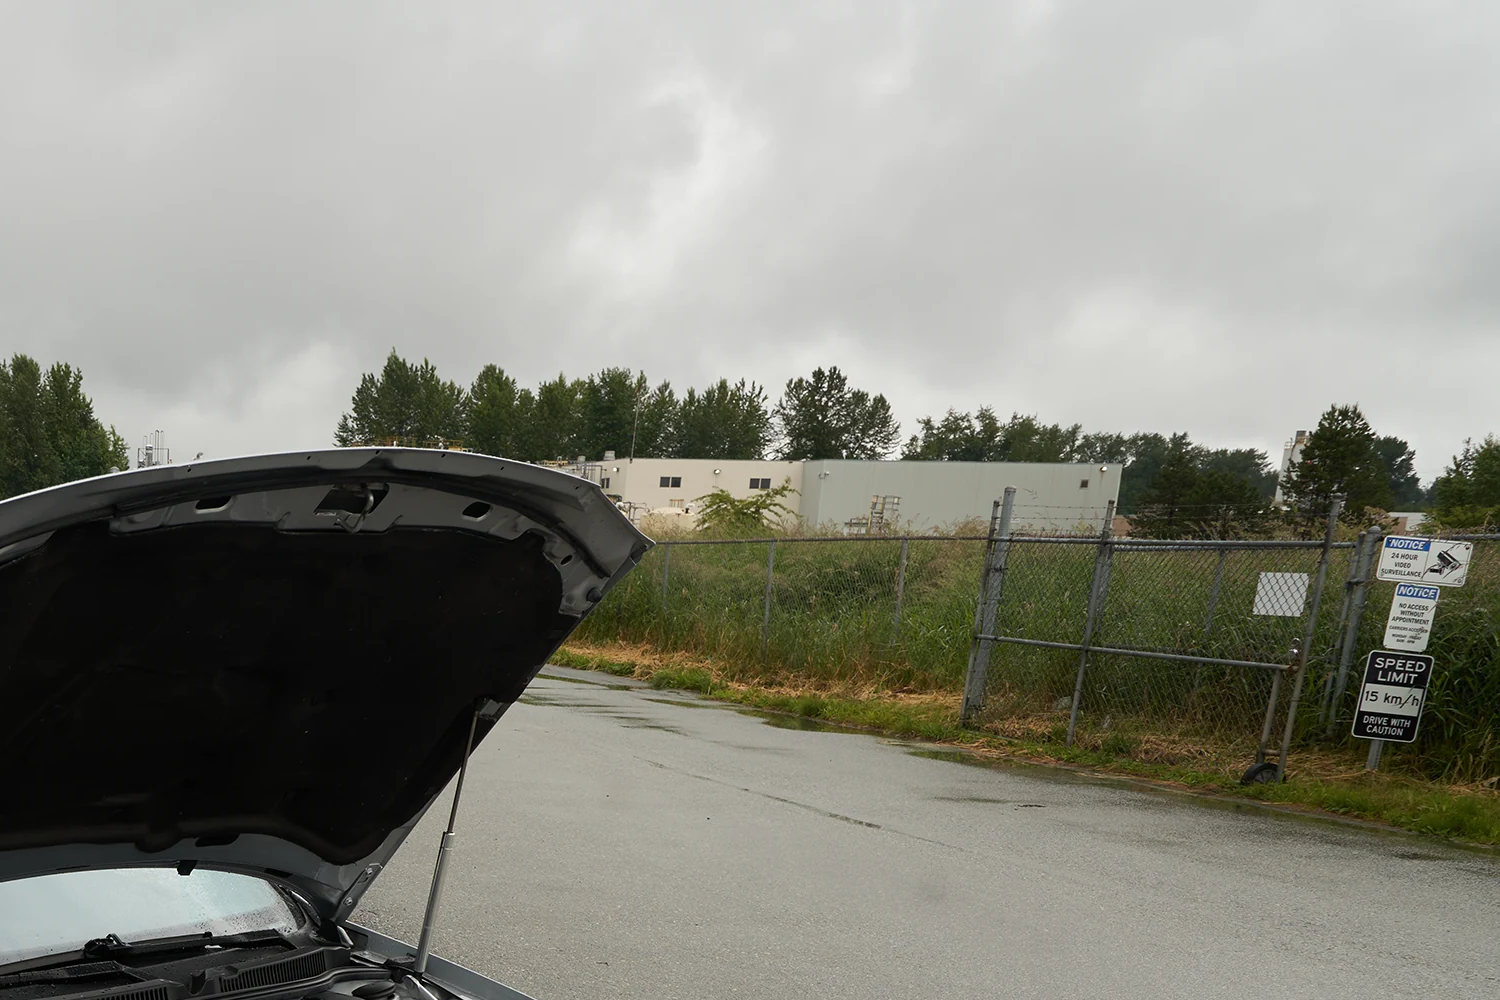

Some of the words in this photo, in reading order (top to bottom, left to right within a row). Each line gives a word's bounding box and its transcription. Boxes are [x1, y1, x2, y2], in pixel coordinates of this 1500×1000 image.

[1389, 539, 1425, 551] NOTICE
[1391, 552, 1400, 560] 24
[1400, 553, 1419, 562] HOUR
[1394, 561, 1412, 570] VIDEO
[1381, 568, 1422, 578] SURVEILLANCE
[1398, 586, 1437, 598] NOTICE
[1400, 610, 1425, 618] WITHOUT
[1391, 616, 1430, 625] APPOINTMENT
[1374, 657, 1426, 673] SPEED
[1377, 670, 1418, 684] LIMIT
[1365, 690, 1379, 702] 15
[1383, 692, 1420, 709] km/h
[1362, 715, 1389, 726] DRIVE
[1390, 718, 1411, 728] WITH
[1366, 725, 1404, 736] CAUTION
